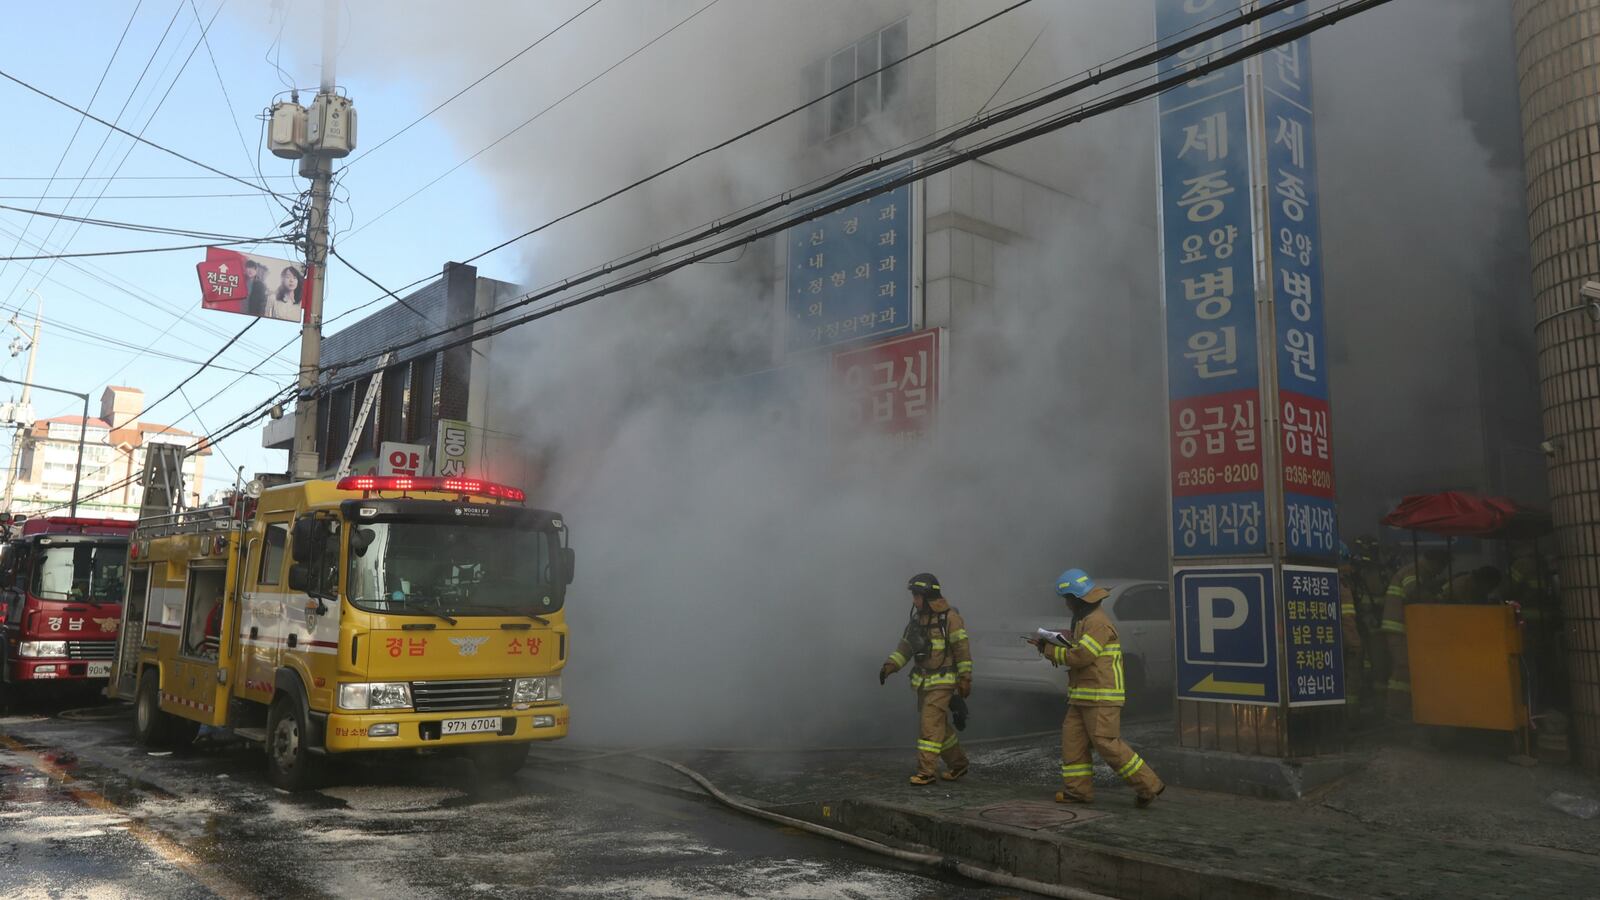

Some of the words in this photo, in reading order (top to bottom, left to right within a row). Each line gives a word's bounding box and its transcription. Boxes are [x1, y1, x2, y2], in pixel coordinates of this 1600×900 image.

[206, 271, 240, 288] 전도연
[211, 283, 234, 297] 거리
[845, 349, 929, 424] 응급실
[1175, 400, 1256, 458] 응급실
[1282, 401, 1328, 461] 응급실
[1190, 463, 1259, 486] 356-8200
[1292, 465, 1332, 489] 356-8200
[1178, 501, 1261, 548] 장례식장
[1287, 503, 1334, 551] 장례식장
[1292, 576, 1330, 596] 주차장은
[48, 617, 85, 631] 경남
[1198, 586, 1249, 653] P
[1292, 625, 1312, 645] 넓은
[1316, 626, 1335, 645] 무료
[385, 637, 428, 658] 경남
[506, 637, 543, 655] 소방
[1296, 649, 1334, 670] 주차장이
[1297, 674, 1335, 695] 있습니다
[470, 718, 496, 731] 6704
